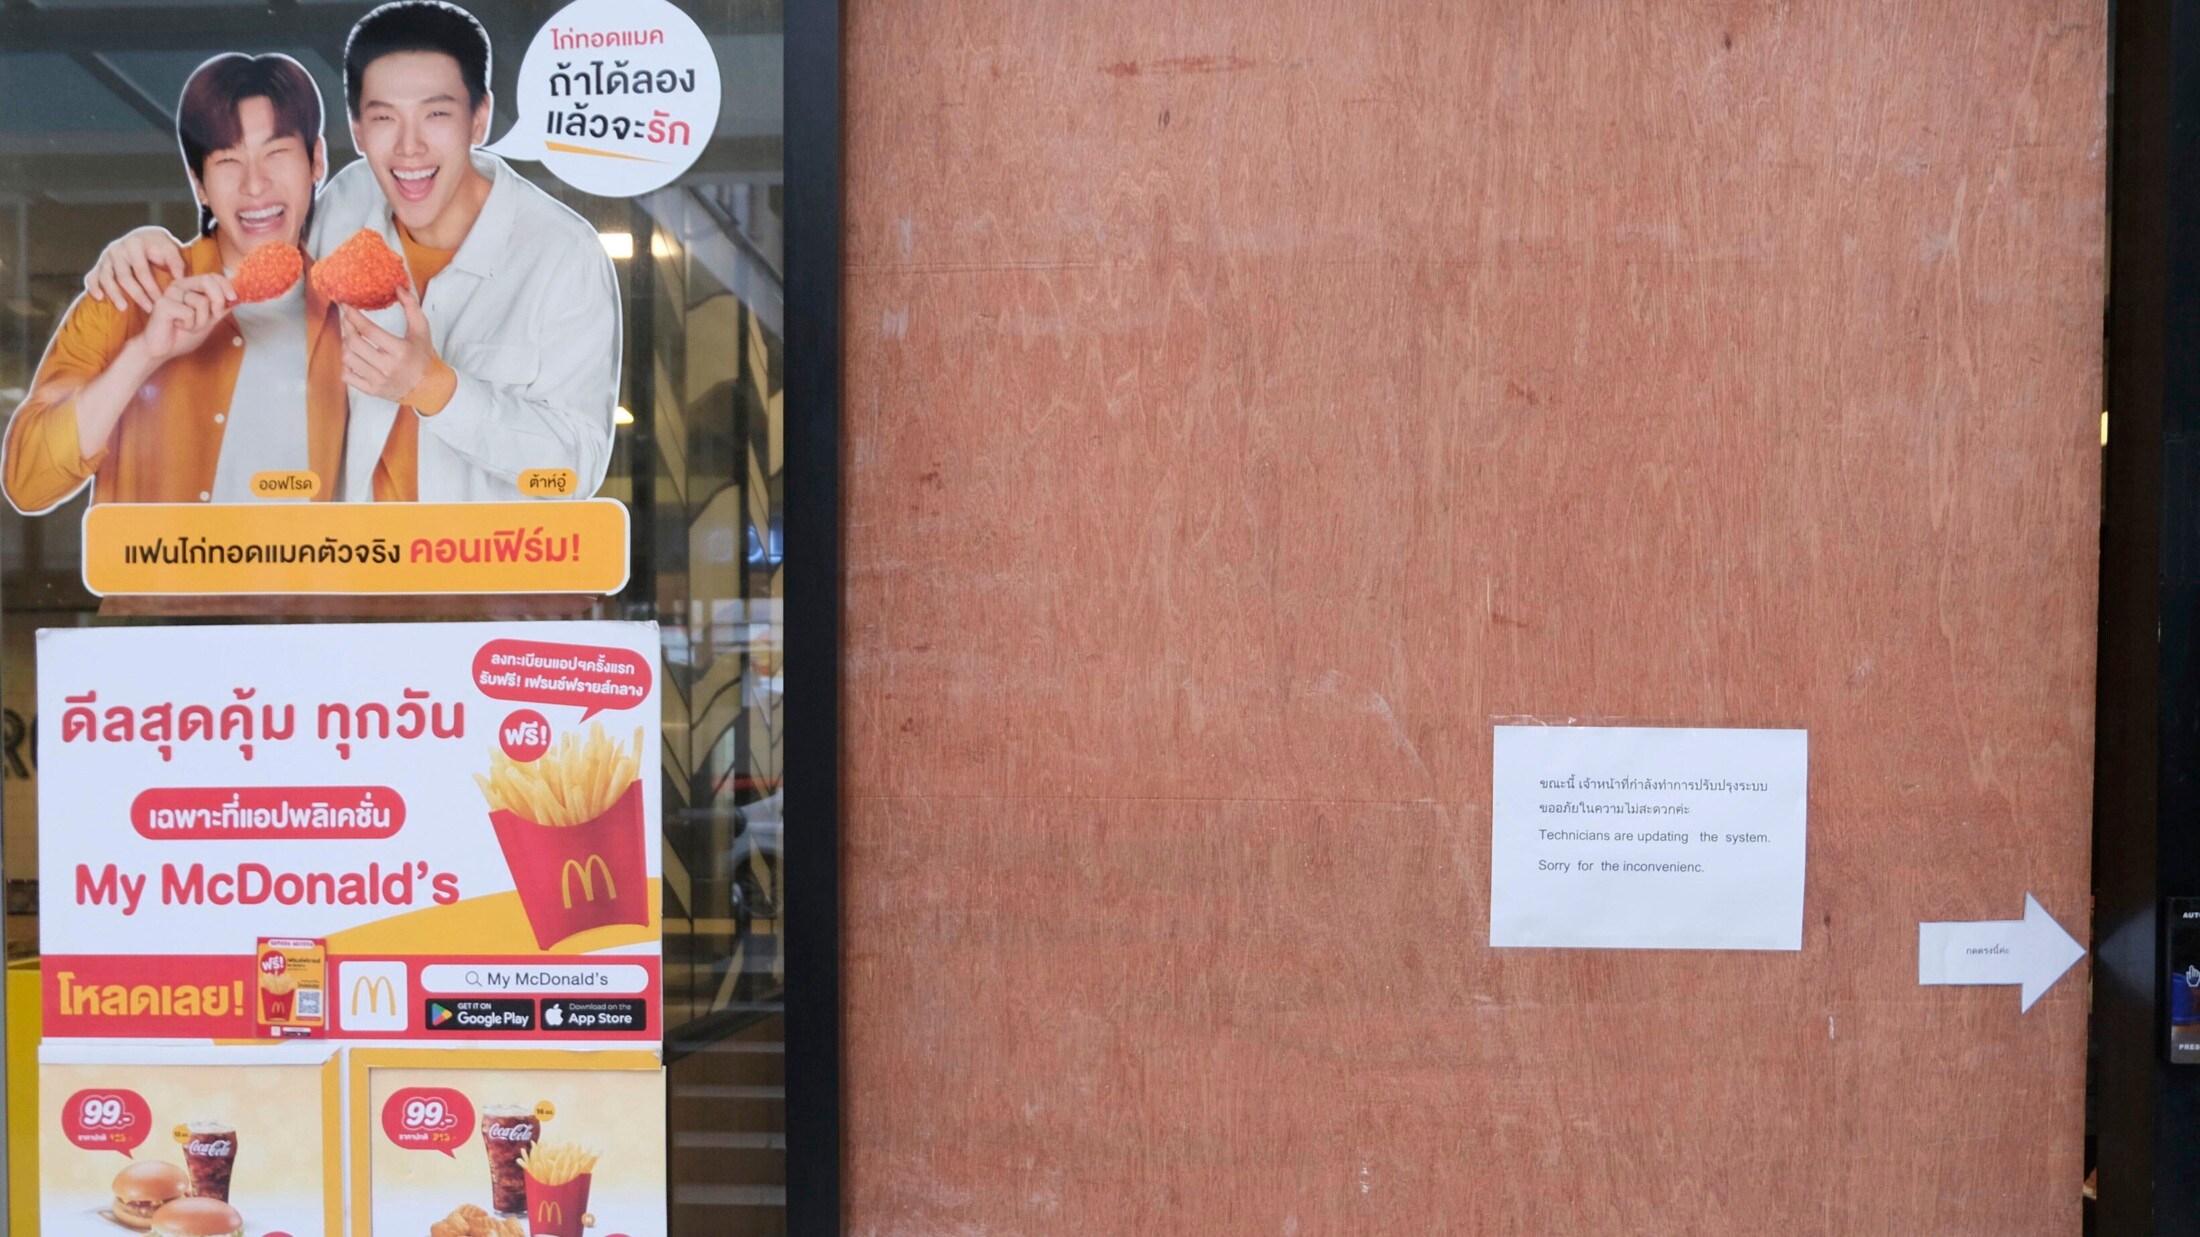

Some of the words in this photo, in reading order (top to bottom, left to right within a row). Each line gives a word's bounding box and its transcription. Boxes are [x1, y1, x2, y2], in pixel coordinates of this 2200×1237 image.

[551, 28, 664, 50] ไก่ทอดแมค
[549, 60, 696, 97] ถ้าได้ลอง
[259, 475, 313, 491] ออฟโรด
[124, 536, 401, 565] แฟนไก่ทอดแมคตัวจริง
[410, 526, 581, 564] คอนเฟิร์ม!
[479, 671, 521, 687] รับฟรี!
[61, 687, 295, 762] ดีลสุดคุ้ม
[317, 687, 465, 760] ทุกวัน
[504, 721, 548, 746] ฟรี!
[1540, 774, 1575, 790] ขณะนี้
[1579, 776, 1768, 793] เจ้าหน้าที่กำลังทำการปรับปรุงระบบ
[149, 792, 391, 829] เฉพาะที่แอปพลิเคชั่น
[1539, 829, 1610, 841] Technicians
[1614, 832, 1633, 841] are
[1638, 831, 1688, 844] updating
[1700, 832, 1718, 842] the
[1725, 833, 1771, 844] system.
[1538, 860, 1570, 873] Sorry
[1578, 860, 1593, 871] for
[1601, 861, 1619, 871] the
[1623, 861, 1704, 872] inconvenienc.
[75, 863, 146, 916] My
[161, 860, 460, 906] McDonald's
[2183, 911, 2200, 919] AUT
[487, 972, 510, 990] My
[57, 971, 244, 1017] โหลดเลย!
[458, 1002, 471, 1010] GET
[569, 1003, 606, 1011] Download
[618, 1003, 631, 1011] the
[458, 1011, 502, 1027] Google
[504, 1011, 529, 1027] Play
[569, 1013, 596, 1026] App
[599, 1012, 633, 1024] Store
